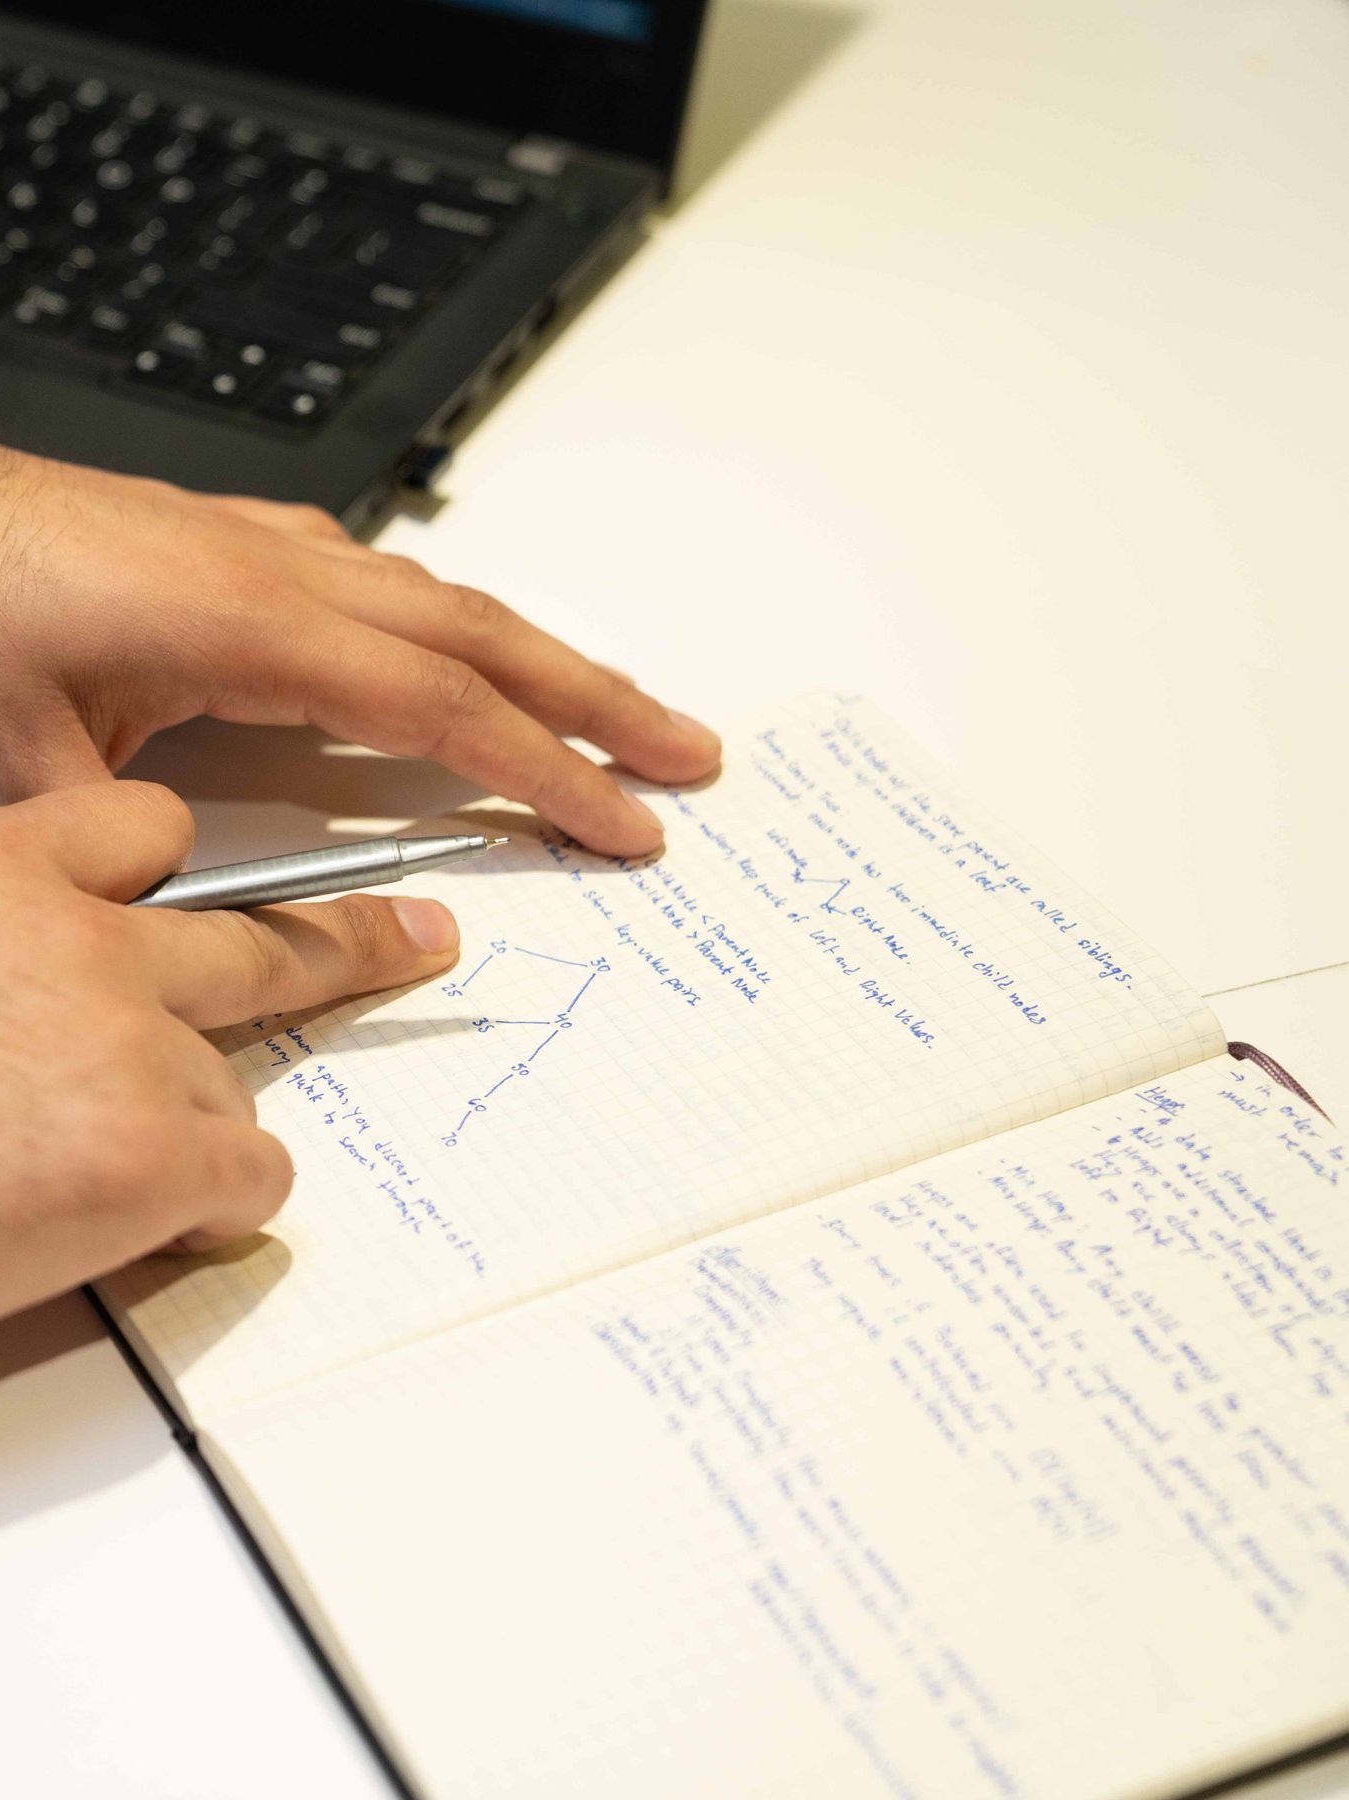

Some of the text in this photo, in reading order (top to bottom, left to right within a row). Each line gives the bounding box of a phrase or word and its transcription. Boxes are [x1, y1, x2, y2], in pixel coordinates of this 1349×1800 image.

[938, 844, 960, 856] is
[954, 859, 967, 869] a
[968, 870, 1008, 893] leaf
[850, 906, 885, 934] Right
[955, 840, 1010, 871] parent
[1005, 875, 1032, 894] are
[1077, 939, 1133, 990] siblings.
[490, 939, 508, 954] 20
[708, 923, 750, 959] Parent
[886, 883, 912, 904] two
[971, 962, 1015, 991] child
[1008, 992, 1047, 1025] nodes
[589, 956, 612, 972] 30
[694, 939, 735, 976] Parent
[730, 977, 760, 1004] Node
[786, 912, 810, 923] of
[808, 929, 841, 955] Left
[835, 956, 861, 976] and
[858, 979, 896, 1008] Right
[441, 982, 464, 997] 25
[471, 1017, 495, 1033] 35
[554, 1012, 573, 1029] 40
[511, 1062, 530, 1076] 50
[265, 1038, 290, 1066] very
[323, 1110, 336, 1125] to
[338, 1136, 376, 1172] search
[286, 1026, 312, 1054] down
[341, 1105, 371, 1135] you
[374, 1140, 420, 1186] discard
[467, 1098, 487, 1112] 60
[1217, 1090, 1268, 1117] must
[1255, 1084, 1272, 1098] in
[1278, 1105, 1321, 1138] order
[440, 1131, 458, 1147] 70
[1175, 1133, 1212, 1162] data
